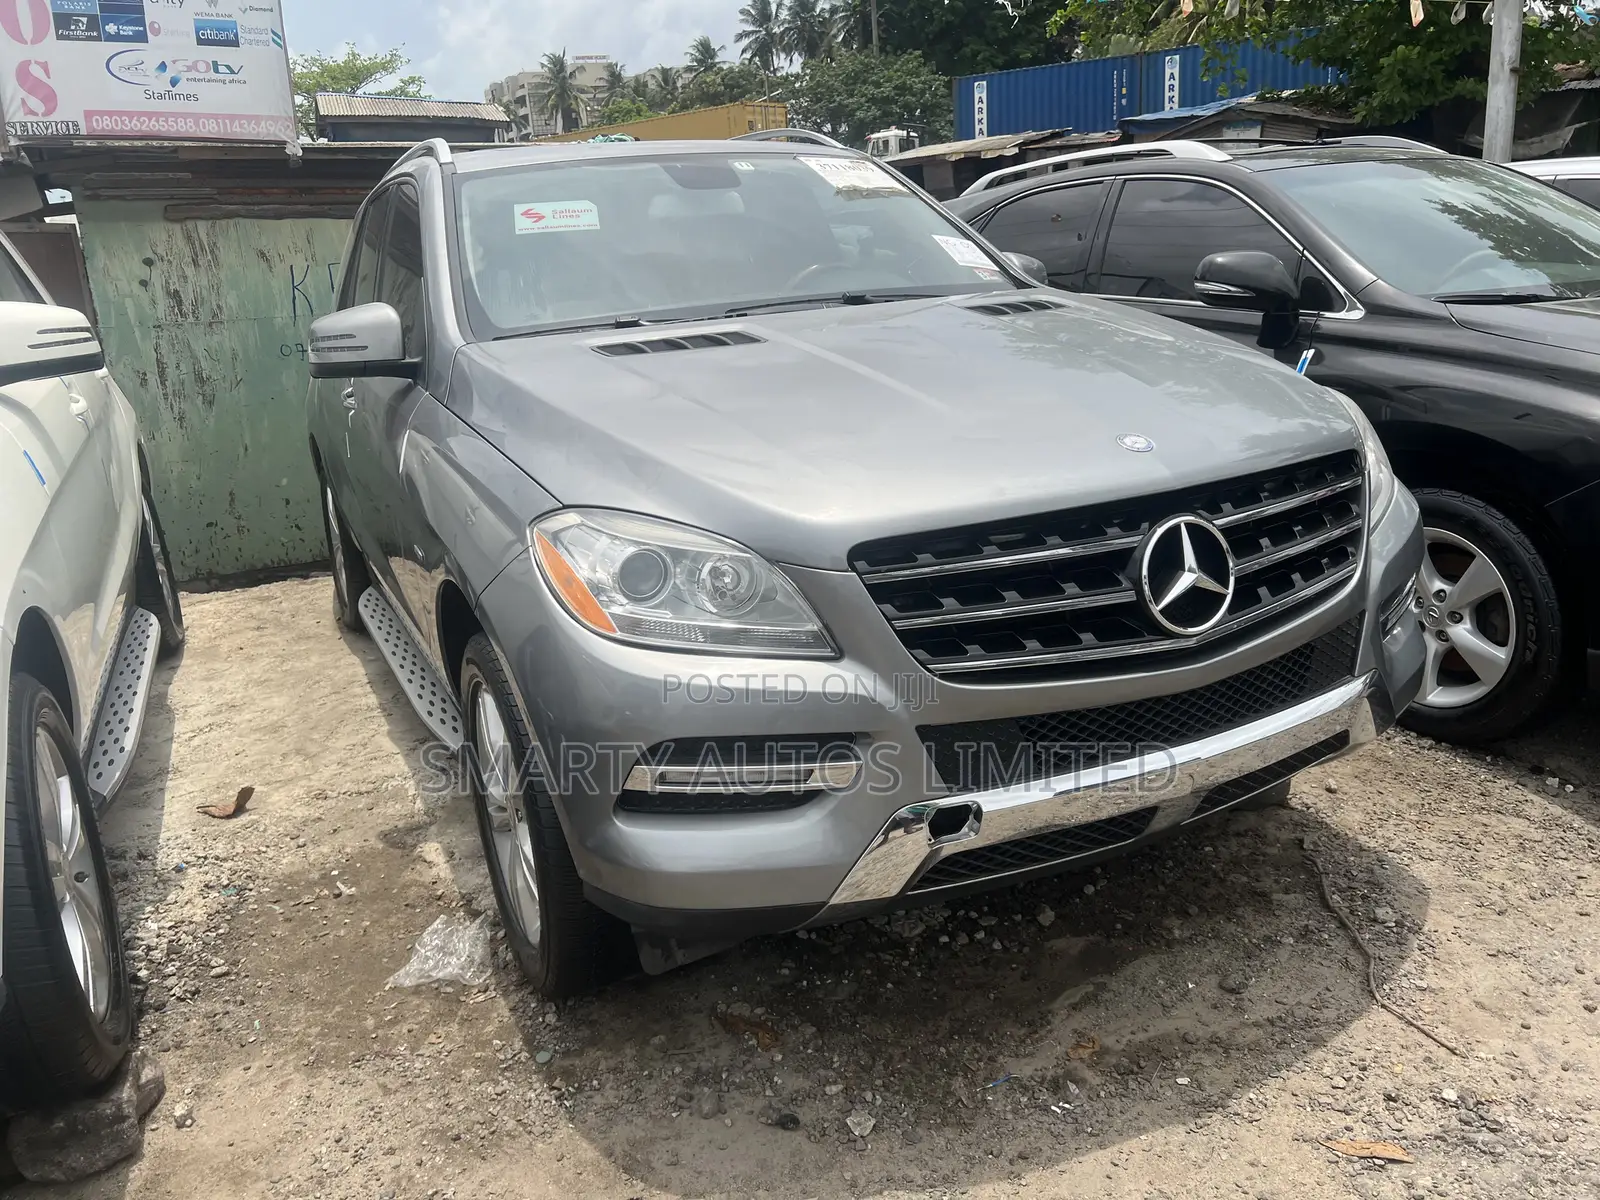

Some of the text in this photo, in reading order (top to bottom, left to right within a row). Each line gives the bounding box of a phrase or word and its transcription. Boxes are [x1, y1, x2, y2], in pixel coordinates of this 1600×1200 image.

[248, 5, 274, 13] Diamond
[58, 29, 98, 37] FirstBank
[199, 27, 237, 41] citibank
[240, 24, 269, 36] Standard
[240, 36, 270, 47] Chartered
[186, 77, 227, 85] entertaining
[144, 89, 199, 102] StarTimes
[977, 95, 985, 137] ARKA
[5, 121, 80, 136] SERVICE
